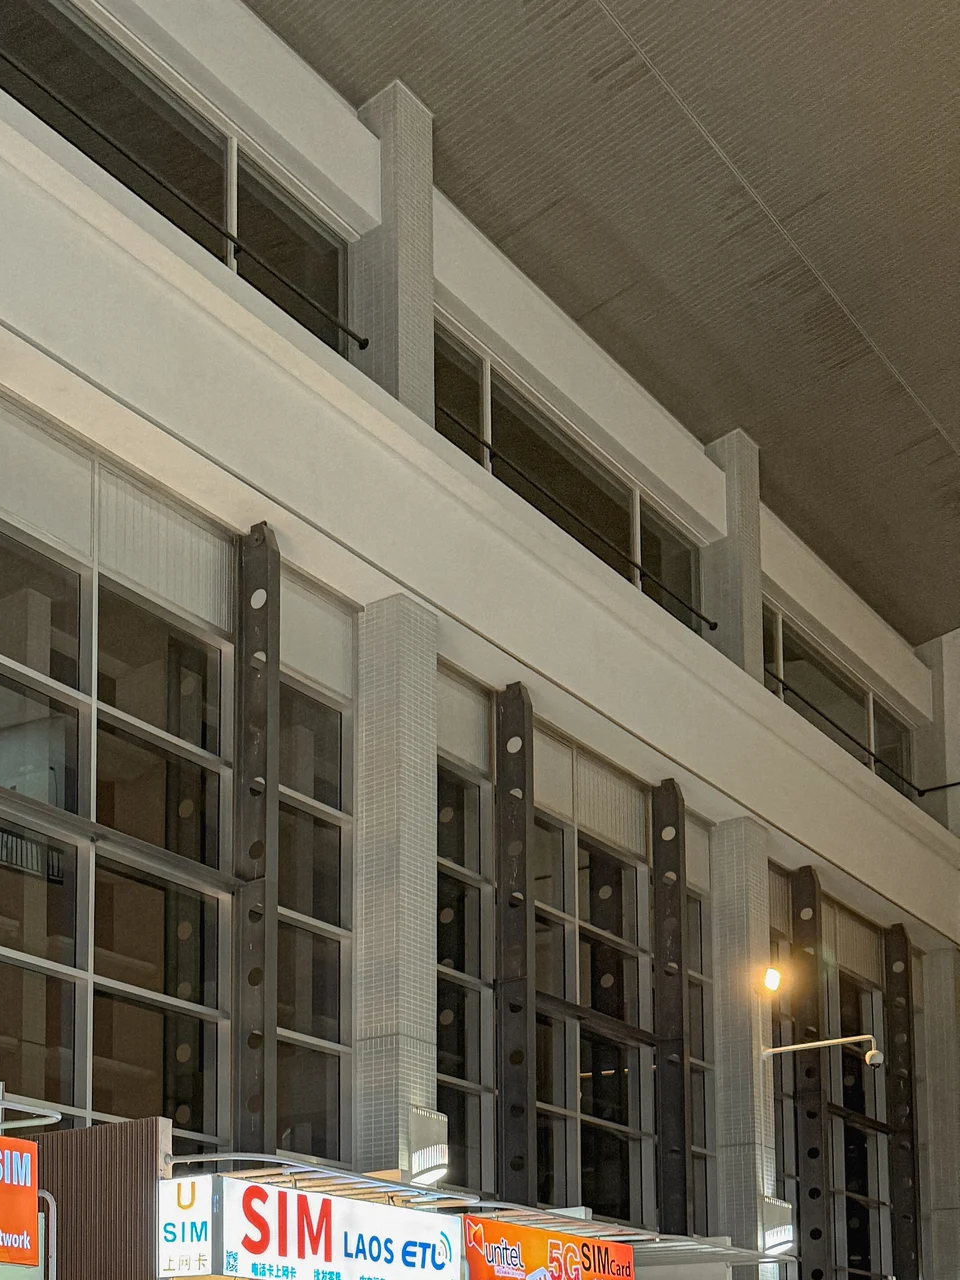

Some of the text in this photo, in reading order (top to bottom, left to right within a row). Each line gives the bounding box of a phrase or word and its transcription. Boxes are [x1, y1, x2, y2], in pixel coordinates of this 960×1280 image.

[177, 1181, 196, 1210] U
[163, 1221, 208, 1243] SIM
[241, 1185, 332, 1263] SIM
[163, 1253, 208, 1272] 上网卡
[344, 1231, 447, 1271] LAOS ETL
[485, 1238, 525, 1269] unitel
